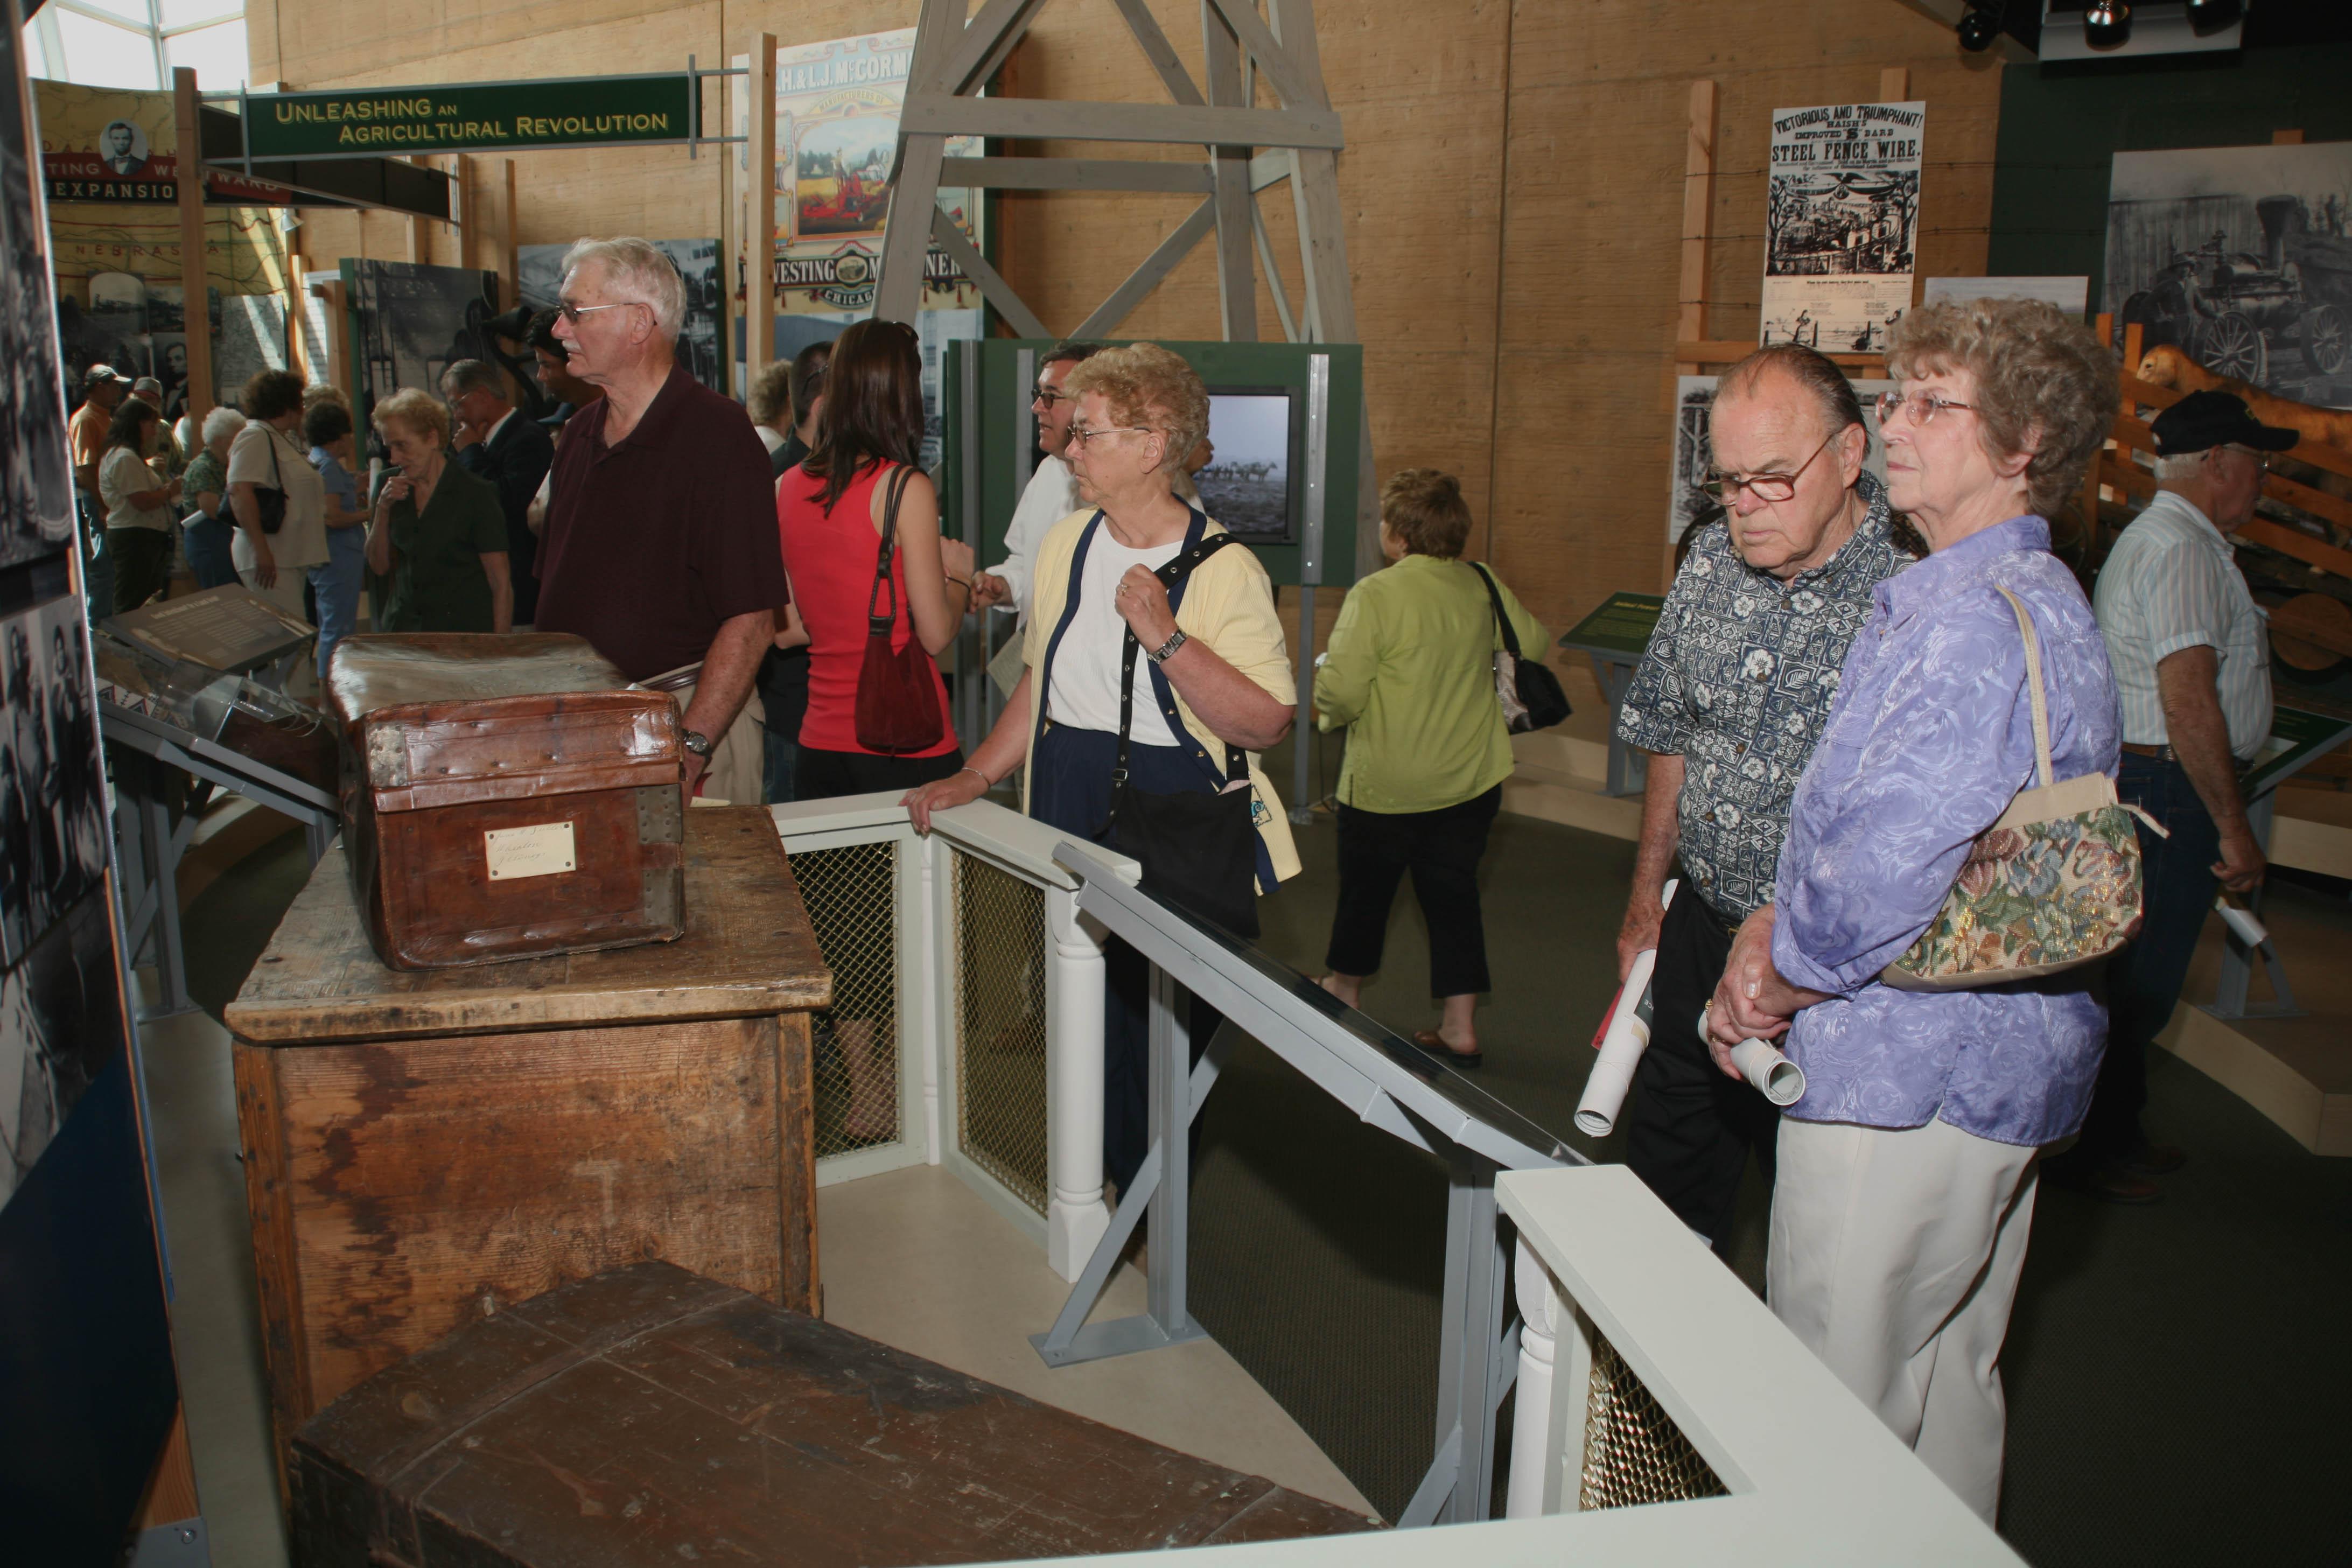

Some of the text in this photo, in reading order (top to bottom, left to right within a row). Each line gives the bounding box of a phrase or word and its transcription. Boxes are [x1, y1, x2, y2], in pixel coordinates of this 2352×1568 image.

[836, 51, 913, 85] McCORM
[437, 104, 459, 116] AN
[819, 90, 874, 112] MANUFACTURERS
[1774, 105, 1923, 135] VICTORIOUS AND TRIUMPHANT!
[1827, 119, 1867, 128] HAISH'S
[1795, 130, 1842, 139] IMPROVED
[1864, 129, 1894, 137] BARB
[1772, 139, 1921, 162] STEEL FENCE WIRE.
[55, 181, 207, 201] EXPANSIO
[75, 242, 219, 257] NEBRASA
